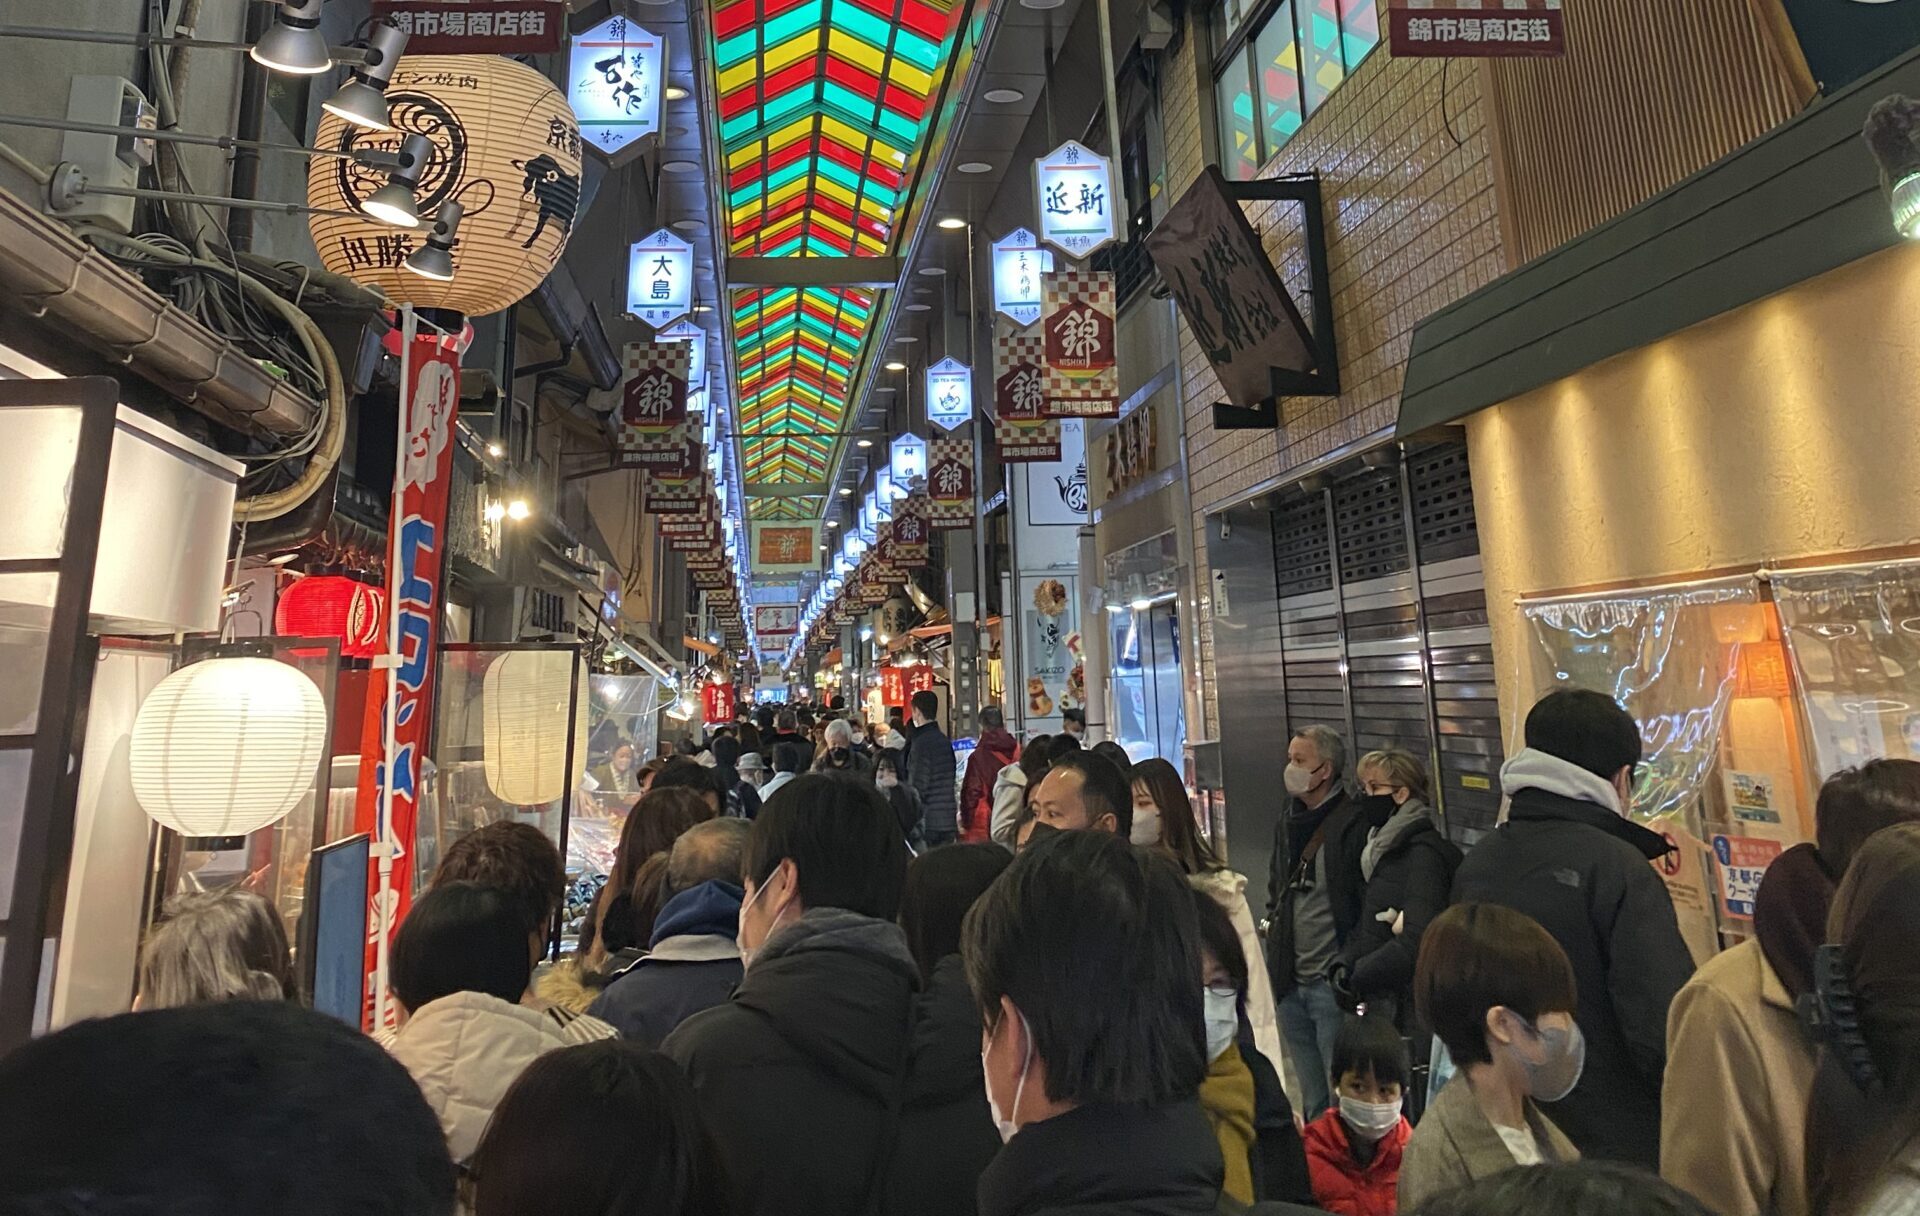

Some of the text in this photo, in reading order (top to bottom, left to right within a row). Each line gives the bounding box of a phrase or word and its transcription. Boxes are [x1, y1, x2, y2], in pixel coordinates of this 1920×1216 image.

[390, 11, 546, 37] 錦市場商店街
[1408, 18, 1551, 42] 錦市場商店街
[395, 71, 479, 90] モン・焼肉
[1046, 181, 1105, 215] 近新
[650, 254, 673, 300] 大島
[1053, 308, 1102, 368] 錦
[1059, 358, 1086, 366] NISHIKI
[632, 373, 673, 425] 錦
[1004, 368, 1044, 419] 錦
[1051, 400, 1113, 413] 錦市場商店街
[934, 462, 963, 500] 錦
